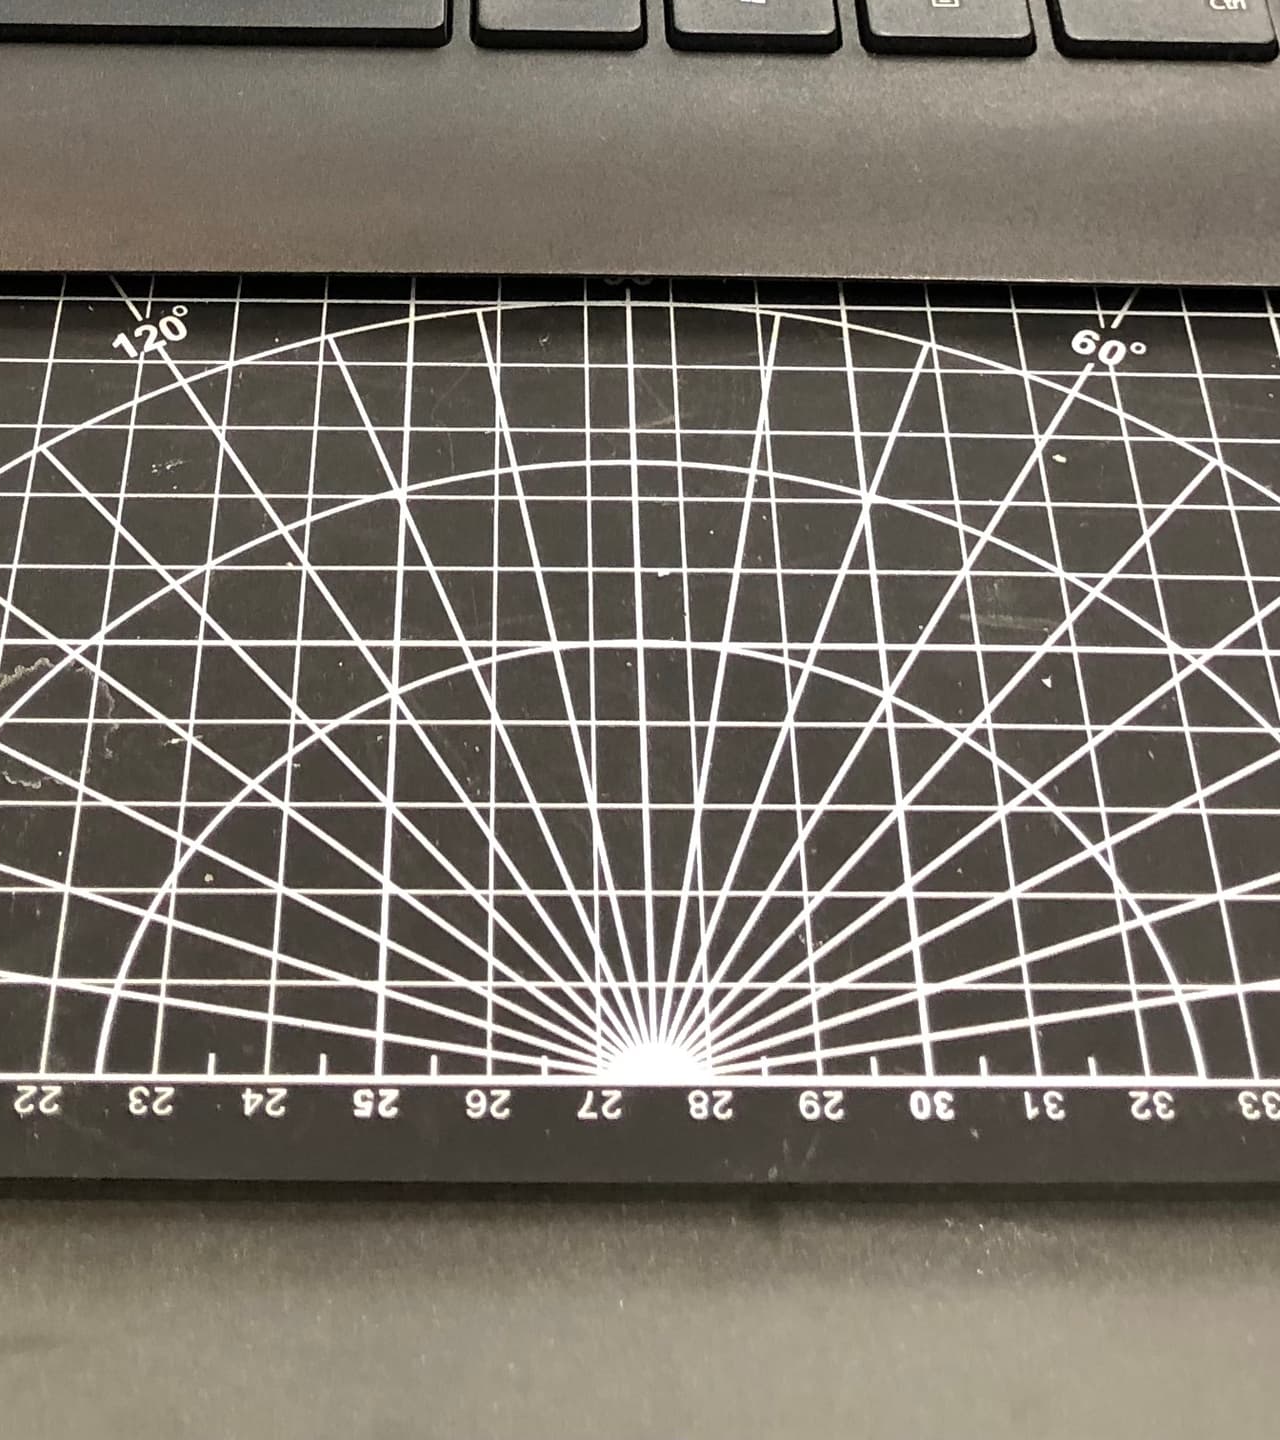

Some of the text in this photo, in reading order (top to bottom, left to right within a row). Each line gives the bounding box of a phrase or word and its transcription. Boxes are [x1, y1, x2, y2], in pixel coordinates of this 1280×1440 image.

[112, 304, 190, 358] 120°
[1070, 329, 1147, 367] 60°
[14, 1086, 62, 1118] 22
[128, 1088, 175, 1116] 23
[241, 1088, 287, 1117] 24
[353, 1088, 399, 1118] 25
[465, 1089, 511, 1119] 26
[577, 1089, 622, 1119] 27
[688, 1089, 733, 1120] 28
[799, 1090, 844, 1120] 29
[909, 1090, 955, 1121] 30
[1024, 1090, 1065, 1120] 31
[1128, 1090, 1175, 1120] 32
